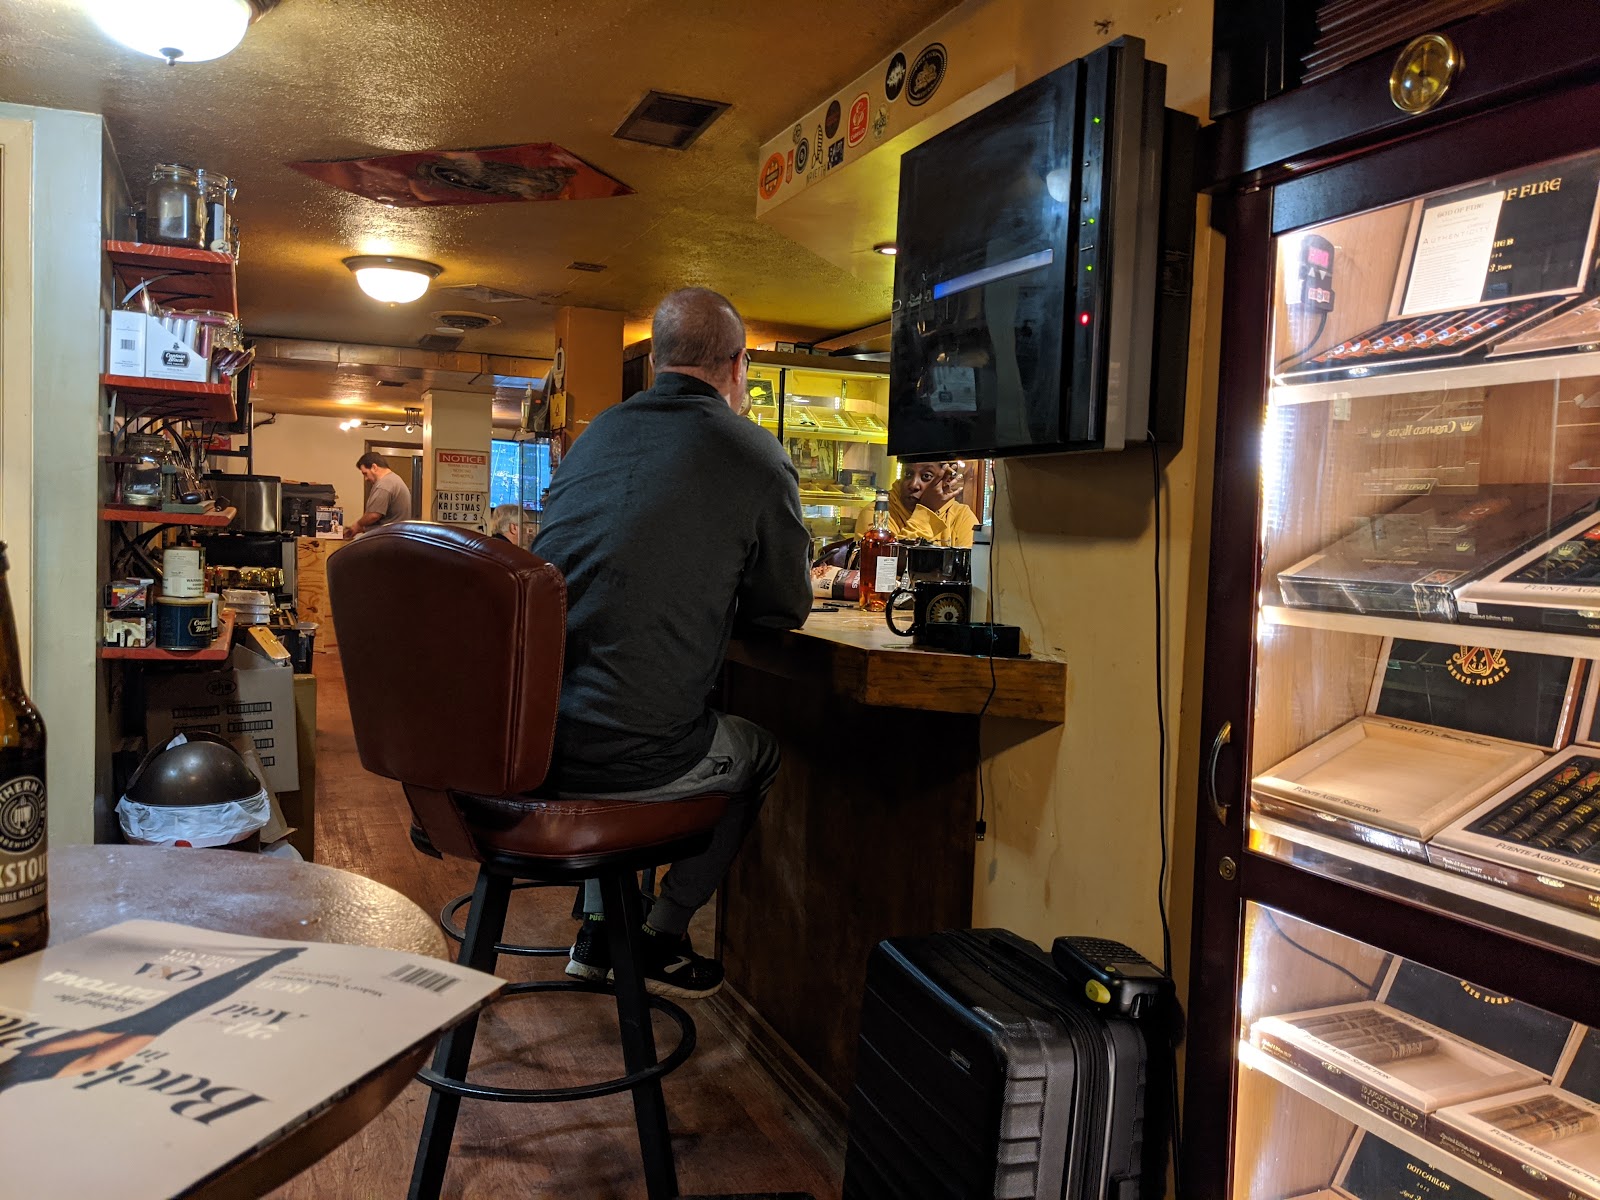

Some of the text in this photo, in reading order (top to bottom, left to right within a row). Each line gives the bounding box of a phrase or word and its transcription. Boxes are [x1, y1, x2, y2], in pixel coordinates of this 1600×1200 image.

[1519, 177, 1562, 199] FIRE
[442, 454, 483, 464] NOTICE
[438, 491, 481, 502] KRISTOFF
[438, 502, 481, 512] KRISTMAS
[442, 512, 458, 521] DEC
[1523, 584, 1569, 593] FUENTE
[1293, 786, 1320, 797] FUENTE
[1341, 799, 1382, 814] SELECTION
[1496, 842, 1531, 855] FUENTE
[1532, 852, 1560, 864] AGED
[1351, 1058, 1392, 1080] SELECTION
[73, 1061, 270, 1127] Back
[1366, 1096, 1391, 1116] LOST
[1391, 1110, 1417, 1128] CITY
[1490, 1128, 1525, 1148] FUENTE
[1525, 1145, 1553, 1160] AGED
[1406, 1163, 1451, 1191] DON CARLOS
